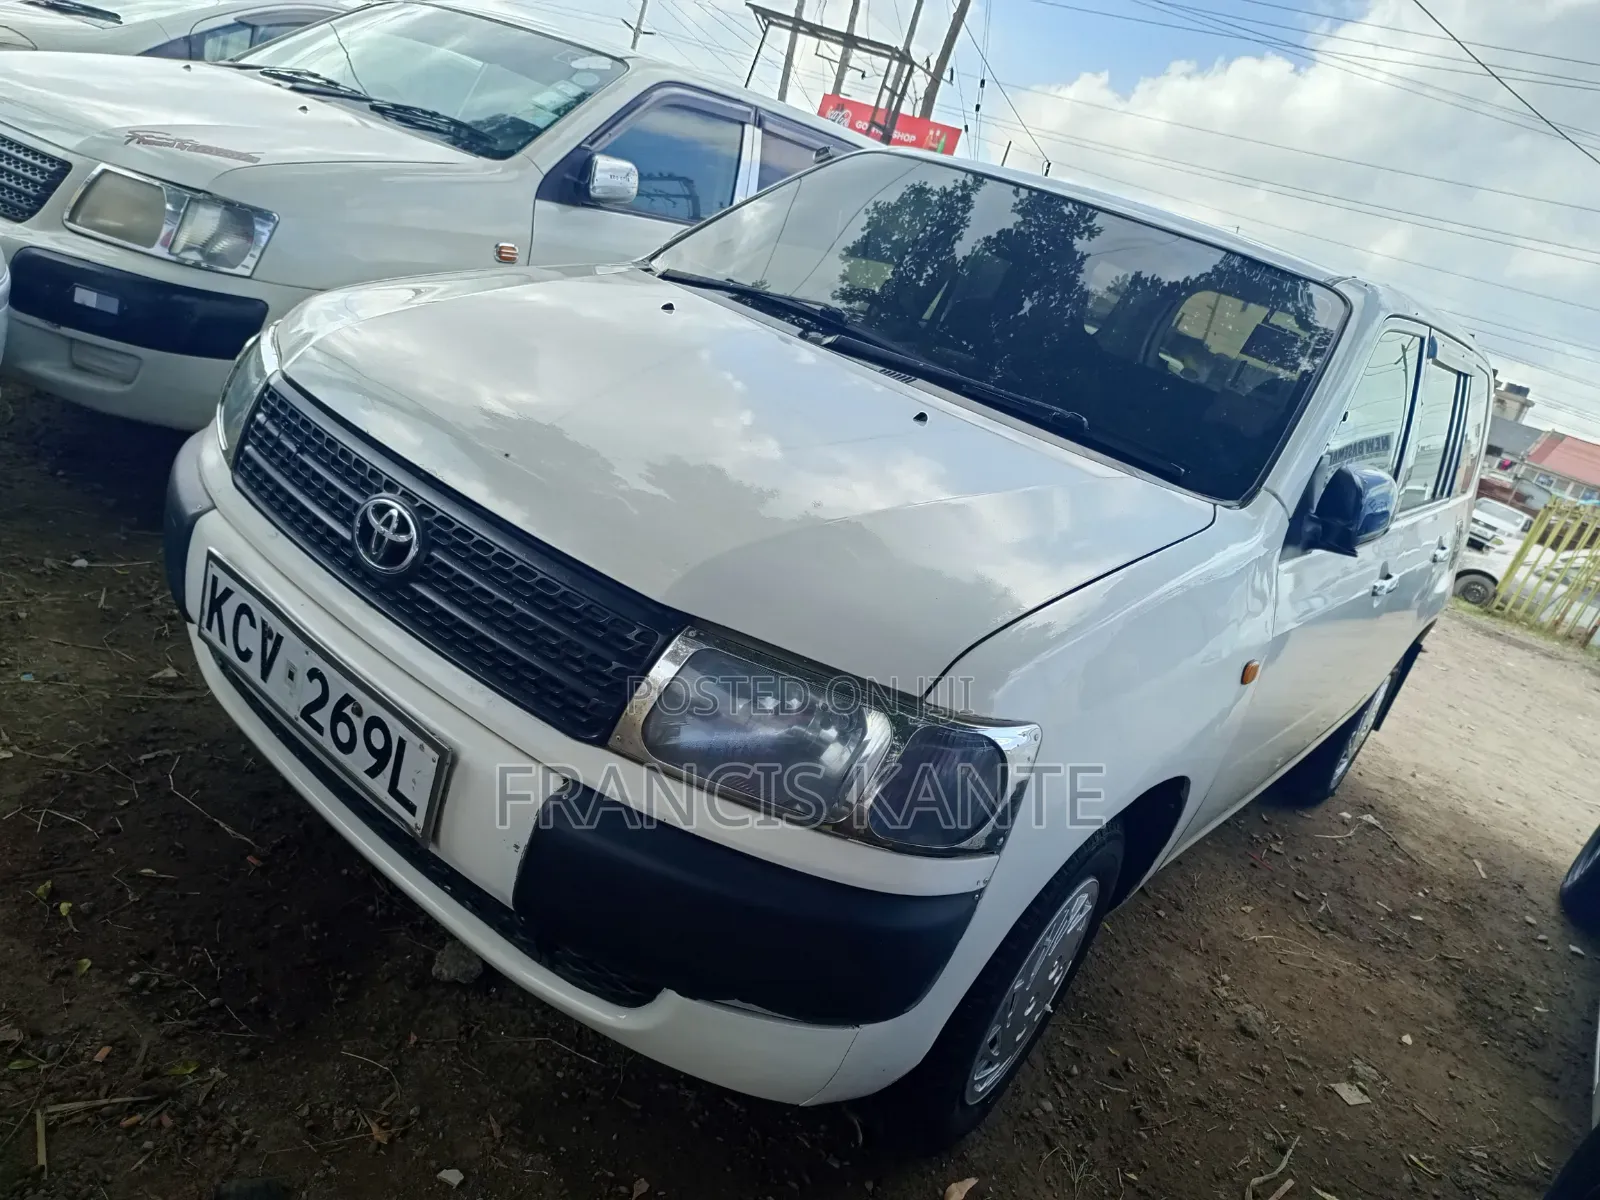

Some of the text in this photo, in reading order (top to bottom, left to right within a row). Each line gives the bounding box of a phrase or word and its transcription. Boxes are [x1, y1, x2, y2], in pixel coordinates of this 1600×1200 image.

[855, 119, 869, 131] GO
[892, 129, 917, 144] SHOP
[206, 573, 418, 818] KCV 269L
